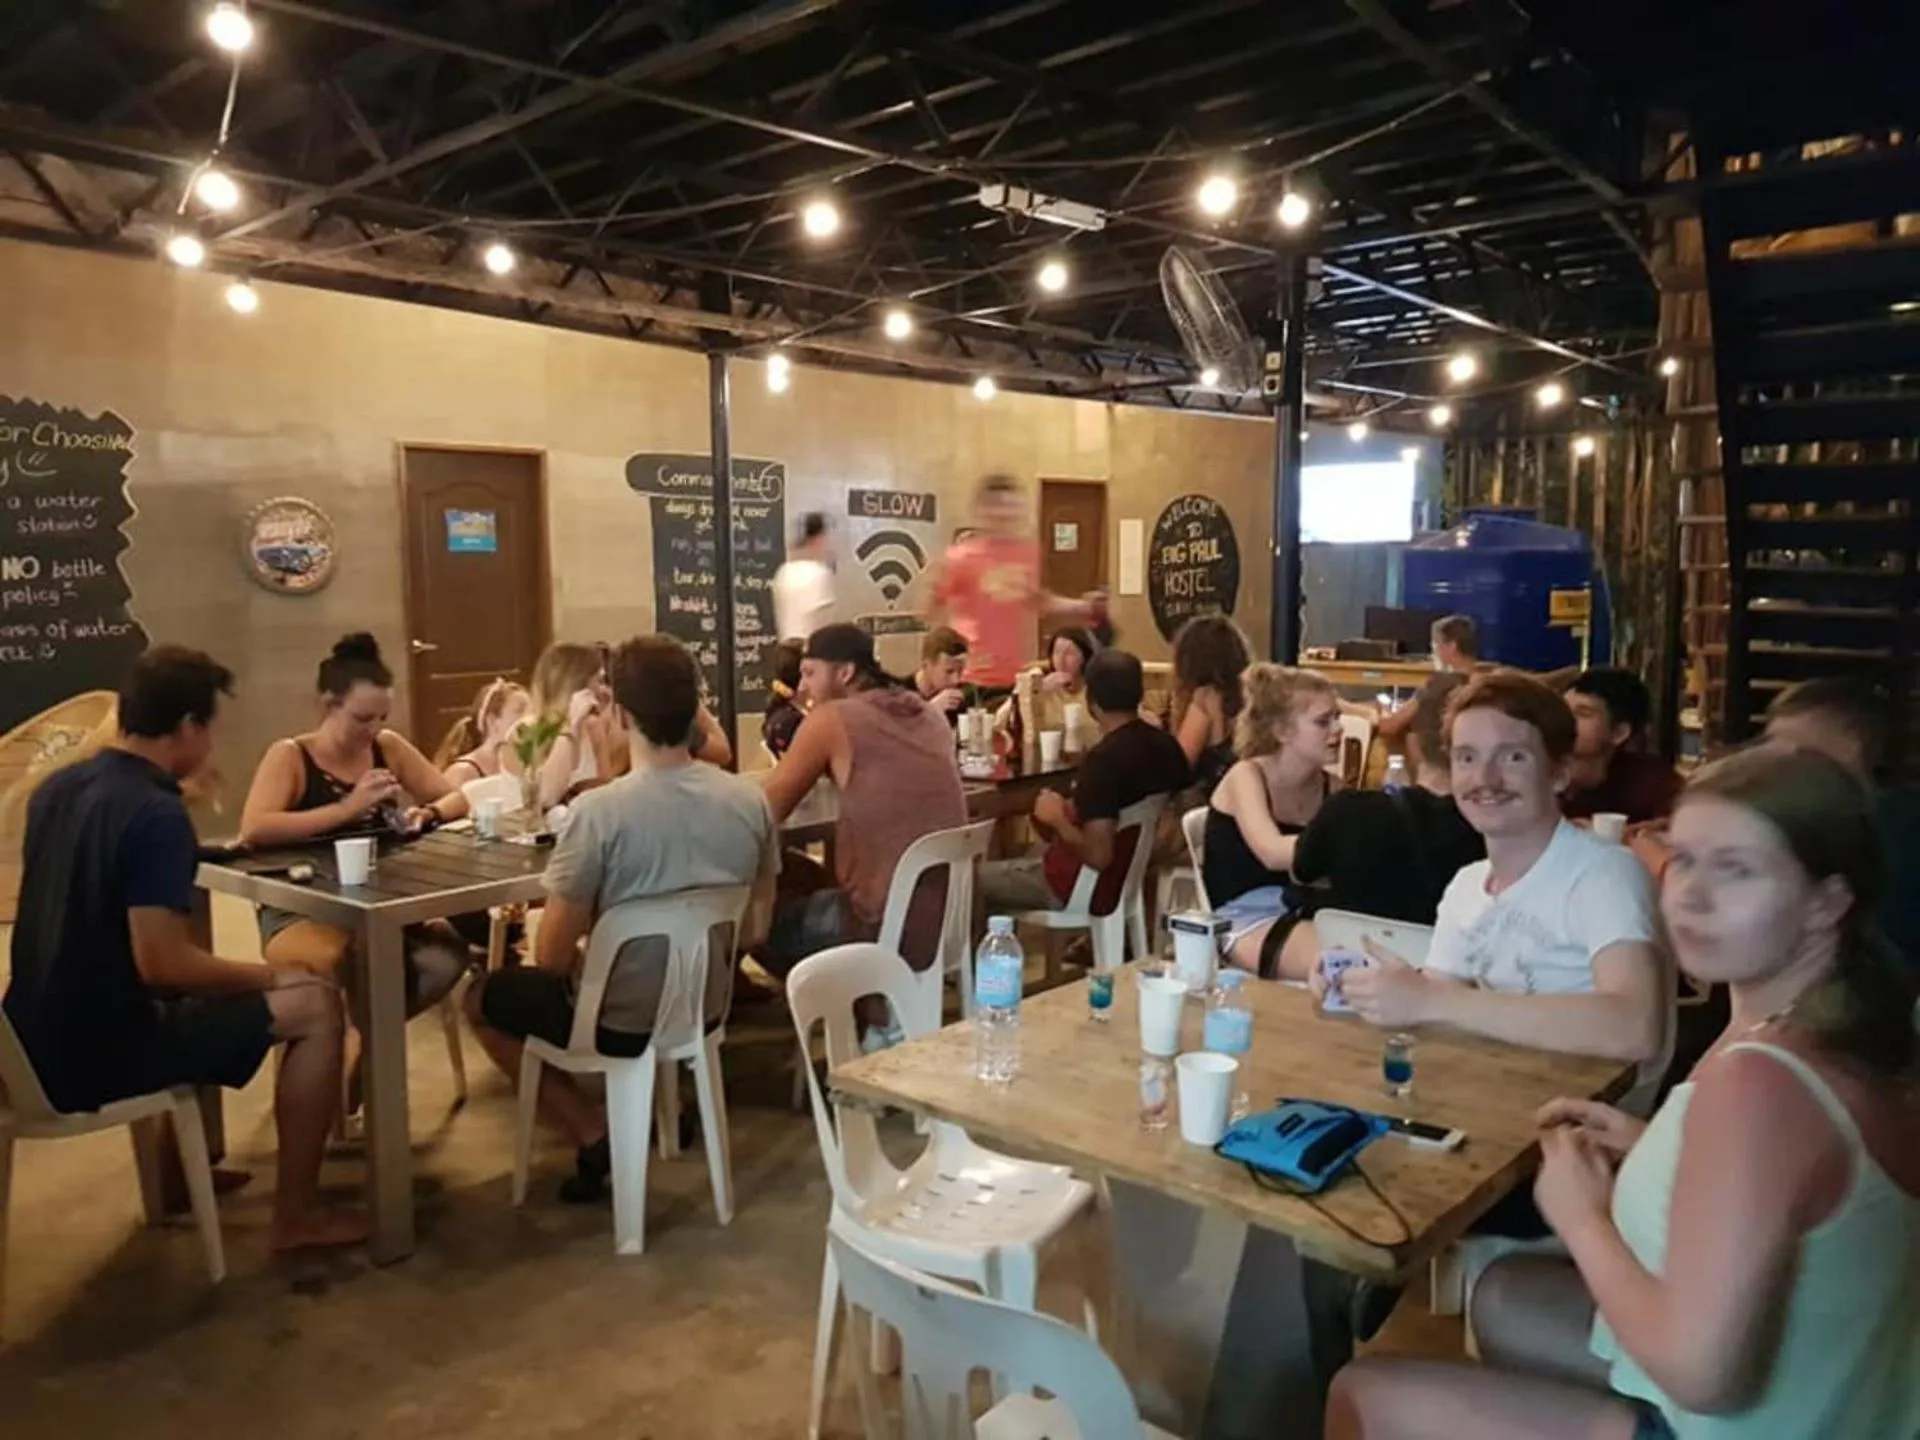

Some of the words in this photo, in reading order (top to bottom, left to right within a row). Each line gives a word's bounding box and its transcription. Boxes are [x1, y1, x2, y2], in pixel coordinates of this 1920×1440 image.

[35, 488, 102, 509] water
[862, 492, 924, 517] SLOW
[1161, 497, 1217, 531] WELCOME
[1161, 541, 1187, 565] BIG
[2, 556, 40, 580] NO
[52, 558, 106, 578] bottle
[1164, 567, 1215, 597] HOSTEL
[3, 585, 60, 611] policy
[46, 619, 68, 641] of
[74, 616, 132, 638] water
